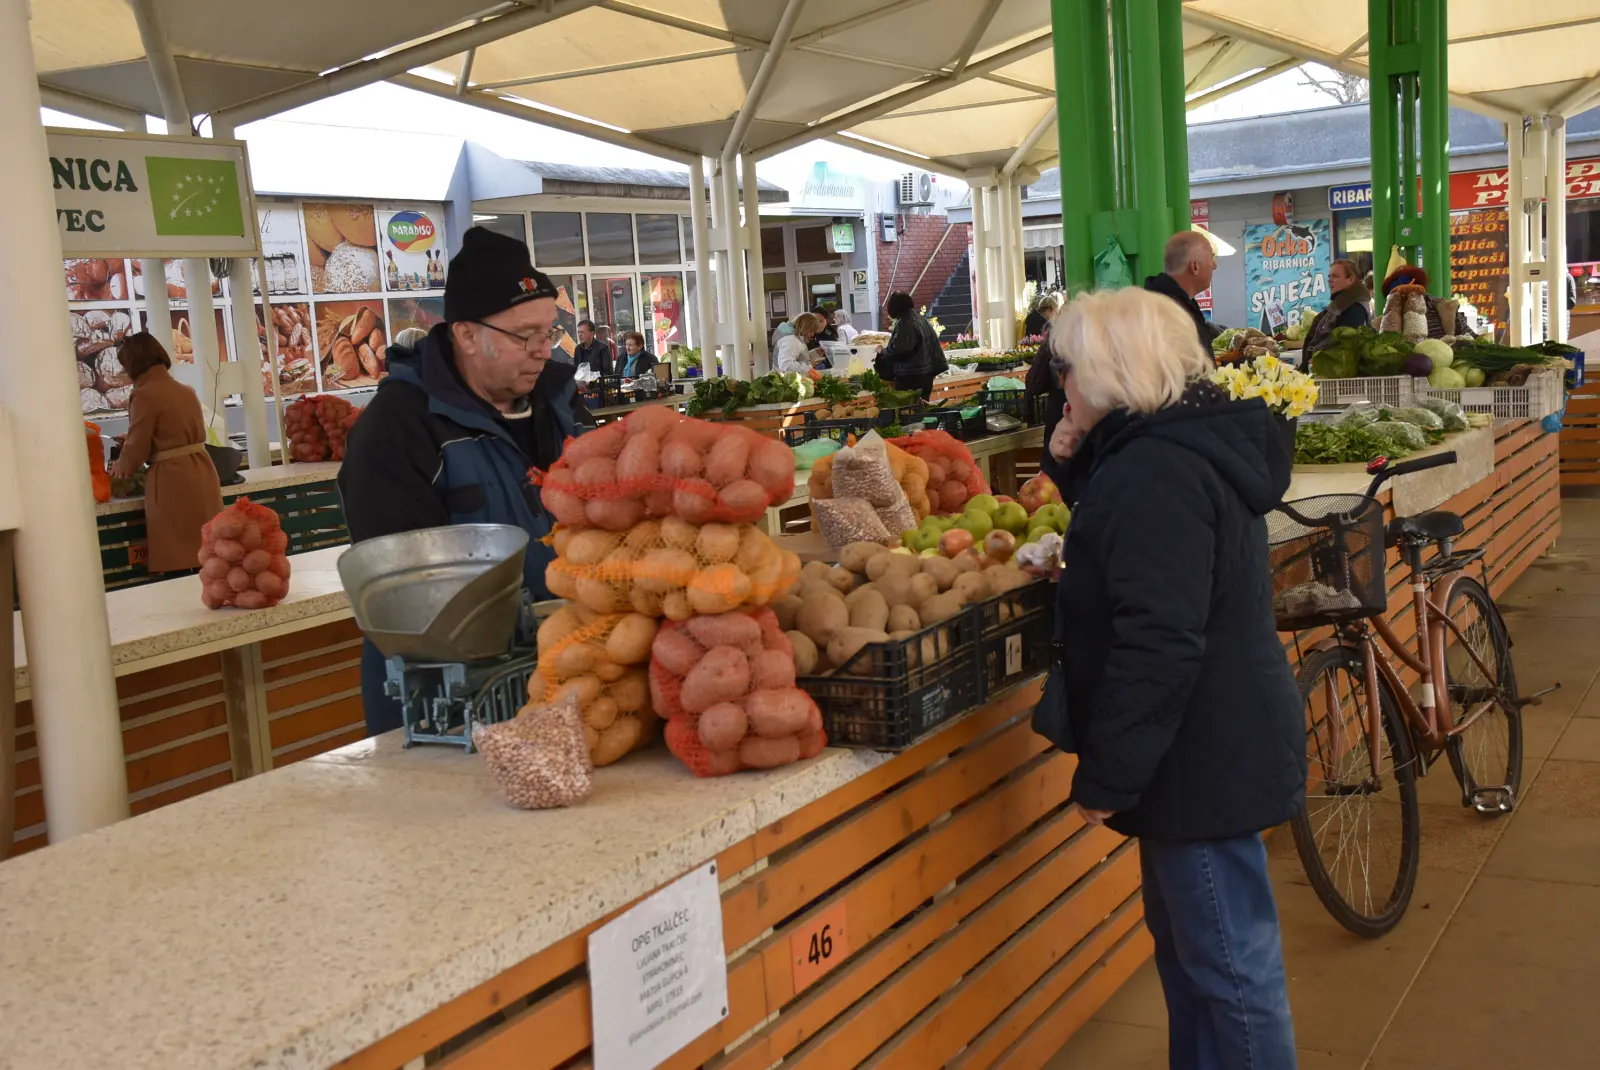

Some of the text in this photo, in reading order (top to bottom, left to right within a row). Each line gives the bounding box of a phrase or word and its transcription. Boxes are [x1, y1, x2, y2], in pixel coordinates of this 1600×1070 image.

[391, 224, 432, 236] PARADISO
[1261, 233, 1308, 258] Orka
[1263, 256, 1315, 270] RIBARNICA
[1251, 270, 1326, 313] SVJEŽA
[631, 908, 690, 953] OPG TKALČEC
[808, 924, 832, 965] 46
